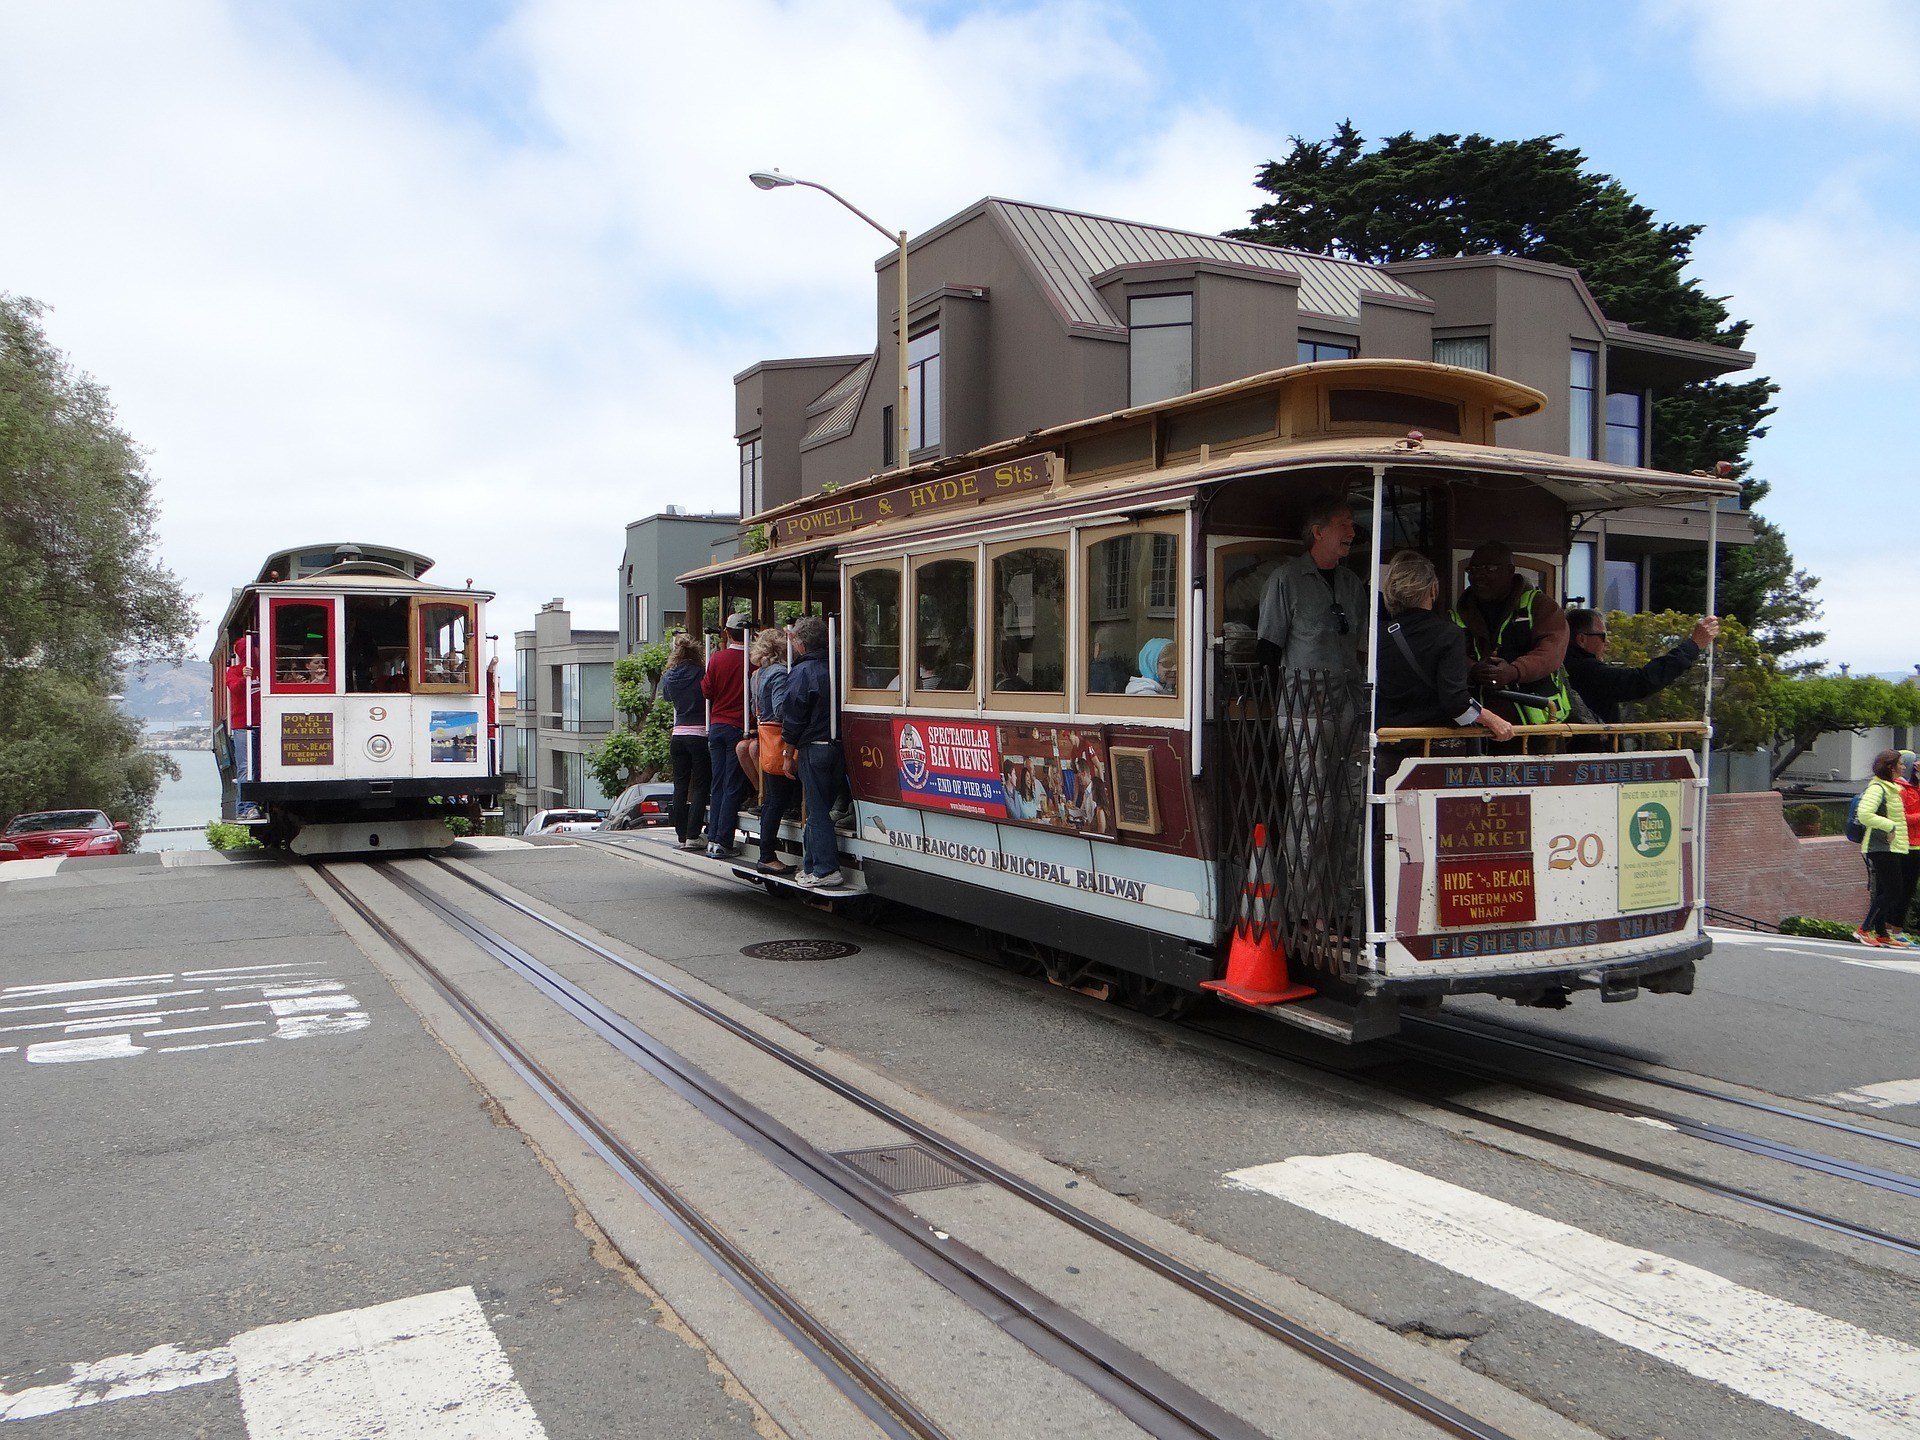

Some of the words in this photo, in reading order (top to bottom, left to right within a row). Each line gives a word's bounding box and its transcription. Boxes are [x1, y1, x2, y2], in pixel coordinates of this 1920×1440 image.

[786, 506, 863, 535] POWELL
[878, 498, 894, 515] &
[909, 475, 979, 507] HYDE
[994, 465, 1039, 488] Sts.
[369, 706, 387, 721] 9
[310, 743, 332, 751] BEACH
[928, 726, 991, 748] SPECTACULAR
[860, 746, 884, 769] 20
[929, 744, 951, 768] BAY
[951, 746, 994, 773] VIEWS!
[1445, 765, 1555, 787] MARKET
[1574, 762, 1656, 785] STREET
[937, 777, 952, 793] END
[952, 779, 961, 794] OF
[962, 780, 982, 797] PIER
[982, 783, 992, 799] 39
[1465, 818, 1507, 831] AND
[1440, 831, 1528, 848] MARKET
[1548, 833, 1604, 870] 20
[889, 830, 913, 849] SAN
[916, 835, 987, 865] FRANCISCO
[1076, 869, 1147, 902] RAILWAY
[1444, 872, 1474, 891] HYDE
[1492, 869, 1531, 888] BEACH
[1452, 891, 1524, 907] FISHERMANS
[1470, 905, 1507, 919] WHARF
[1431, 923, 1599, 959] FISHERMANS
[1617, 913, 1678, 939] WHARF
